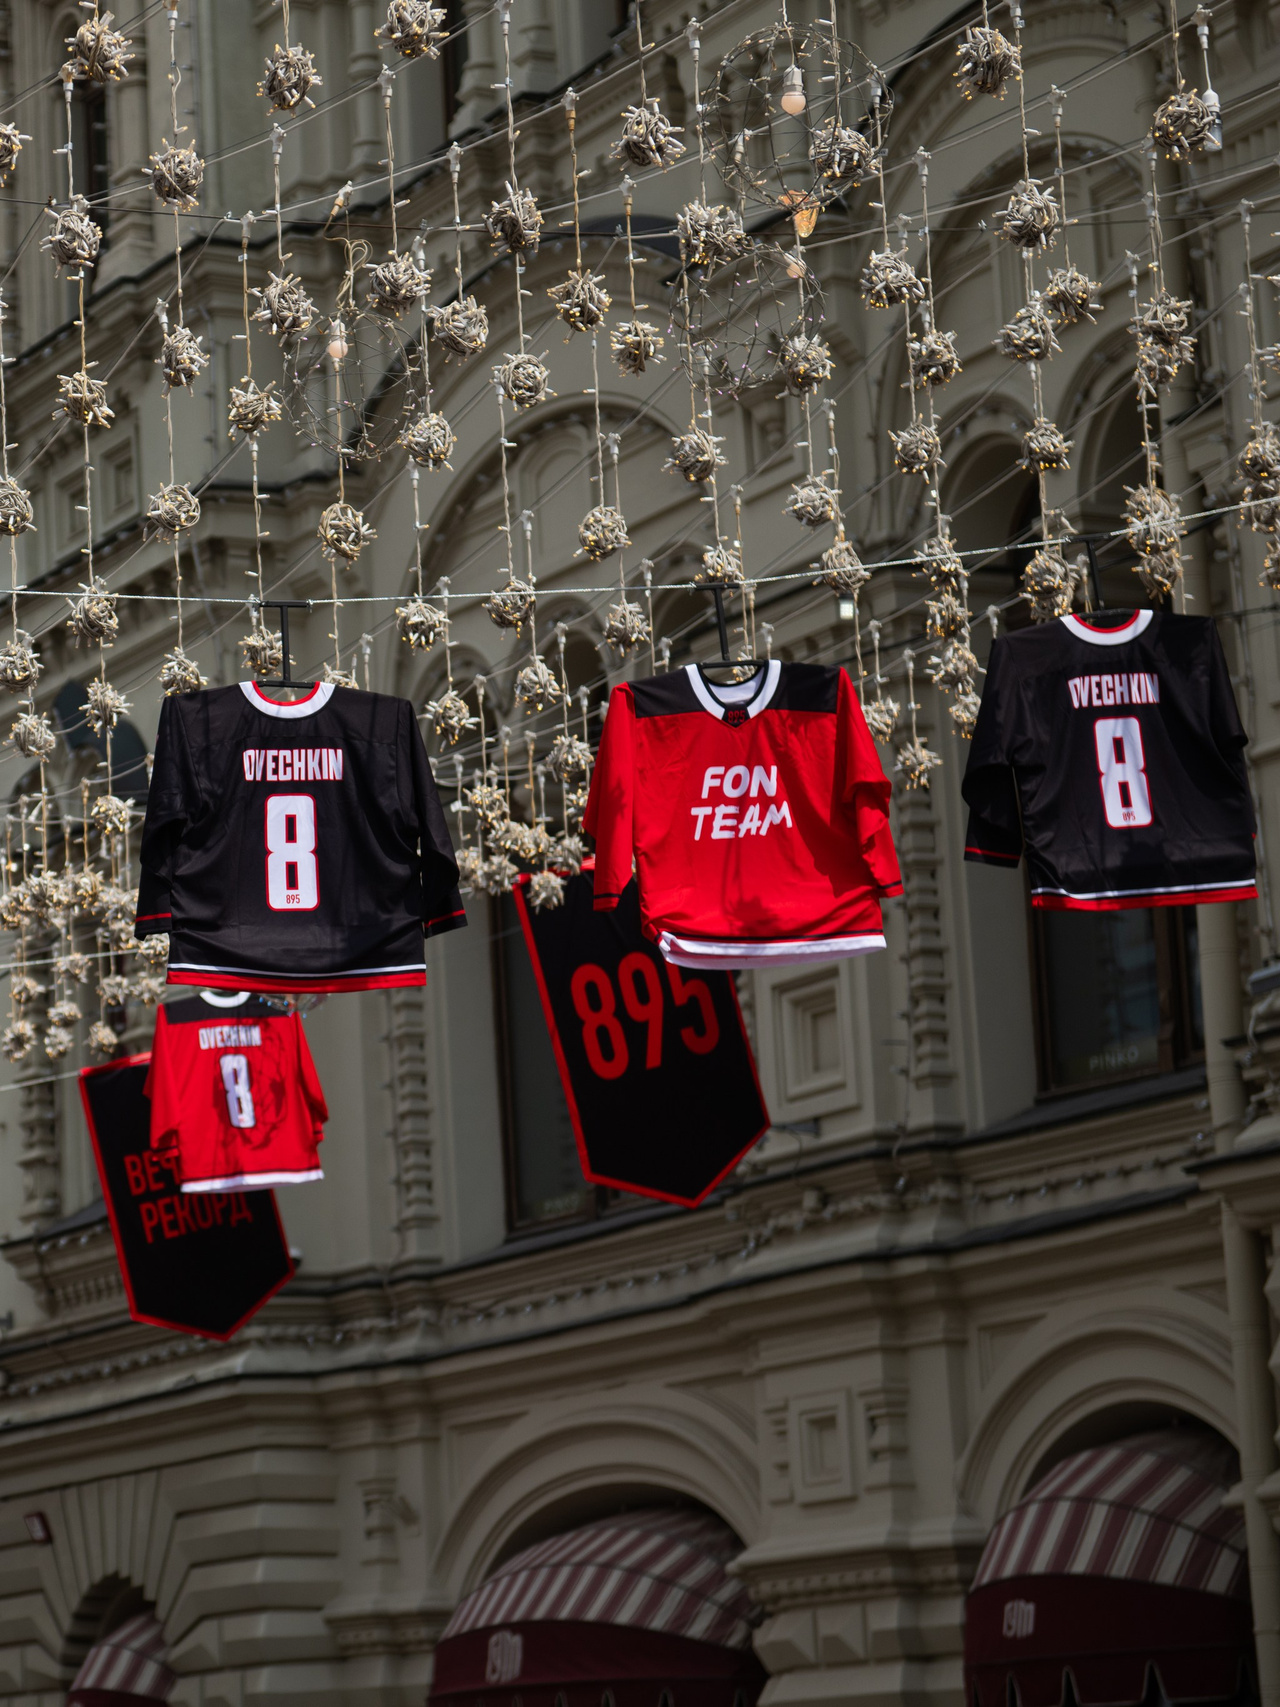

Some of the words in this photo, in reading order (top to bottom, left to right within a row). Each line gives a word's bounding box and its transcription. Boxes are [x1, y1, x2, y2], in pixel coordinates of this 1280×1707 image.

[1068, 673, 1160, 709] OVECHKIN
[727, 710, 746, 723] 895
[242, 748, 344, 781] OVECHKIN
[701, 765, 778, 799] FON
[1094, 715, 1155, 830] 8
[690, 801, 792, 841] TEAM
[264, 793, 321, 912] 8
[285, 894, 301, 905] 895
[571, 951, 720, 1080] 895
[199, 1025, 262, 1050] OVECHKIN
[219, 1054, 256, 1128] 8
